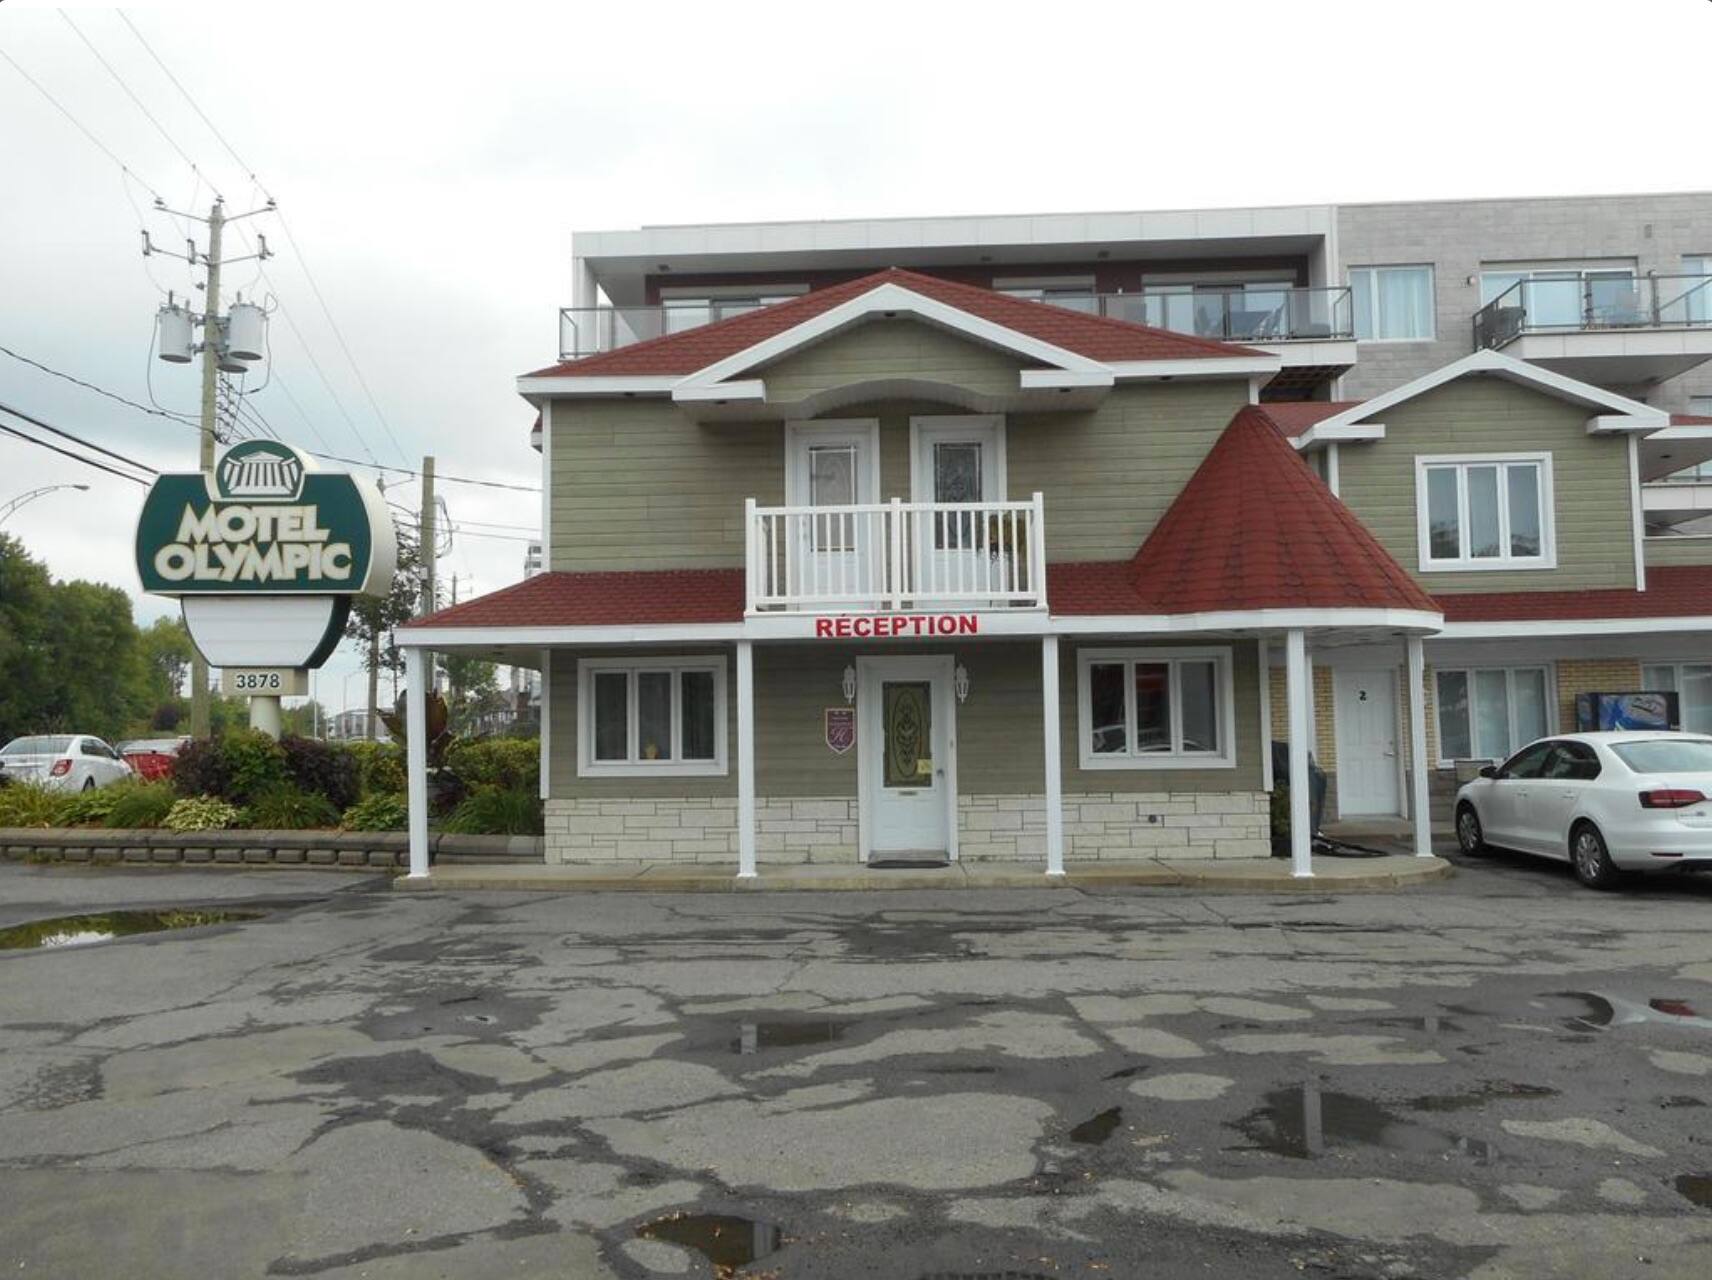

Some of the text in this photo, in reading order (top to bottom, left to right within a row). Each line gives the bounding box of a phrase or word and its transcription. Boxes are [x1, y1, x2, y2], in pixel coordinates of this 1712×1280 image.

[175, 503, 330, 542] MOTEL
[154, 542, 351, 583] OLYMPIC
[236, 673, 280, 688] 3878
[1358, 689, 1367, 702] 2
